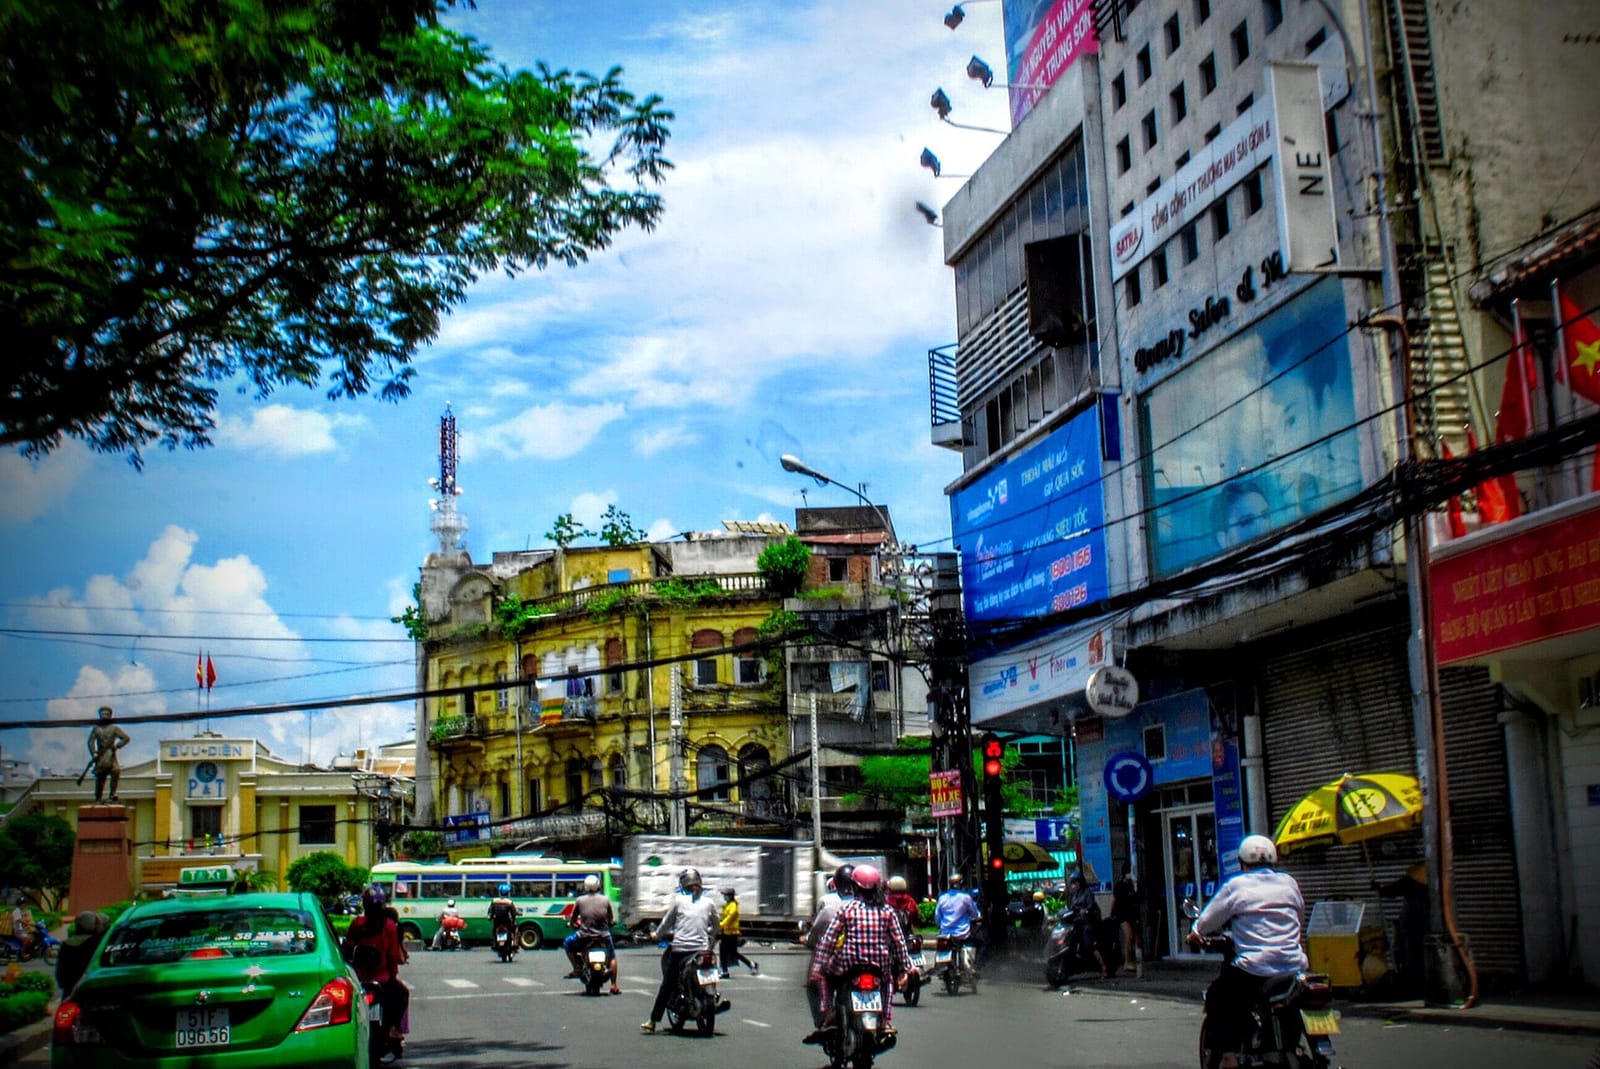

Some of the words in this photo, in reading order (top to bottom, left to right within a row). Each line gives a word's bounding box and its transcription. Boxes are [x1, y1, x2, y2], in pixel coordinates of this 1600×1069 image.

[1116, 228, 1138, 257] SATRA
[188, 779, 198, 797] P
[203, 784, 210, 795] &
[216, 778, 224, 797] T
[298, 930, 315, 939] 38
[177, 1026, 229, 1046] 096.56
